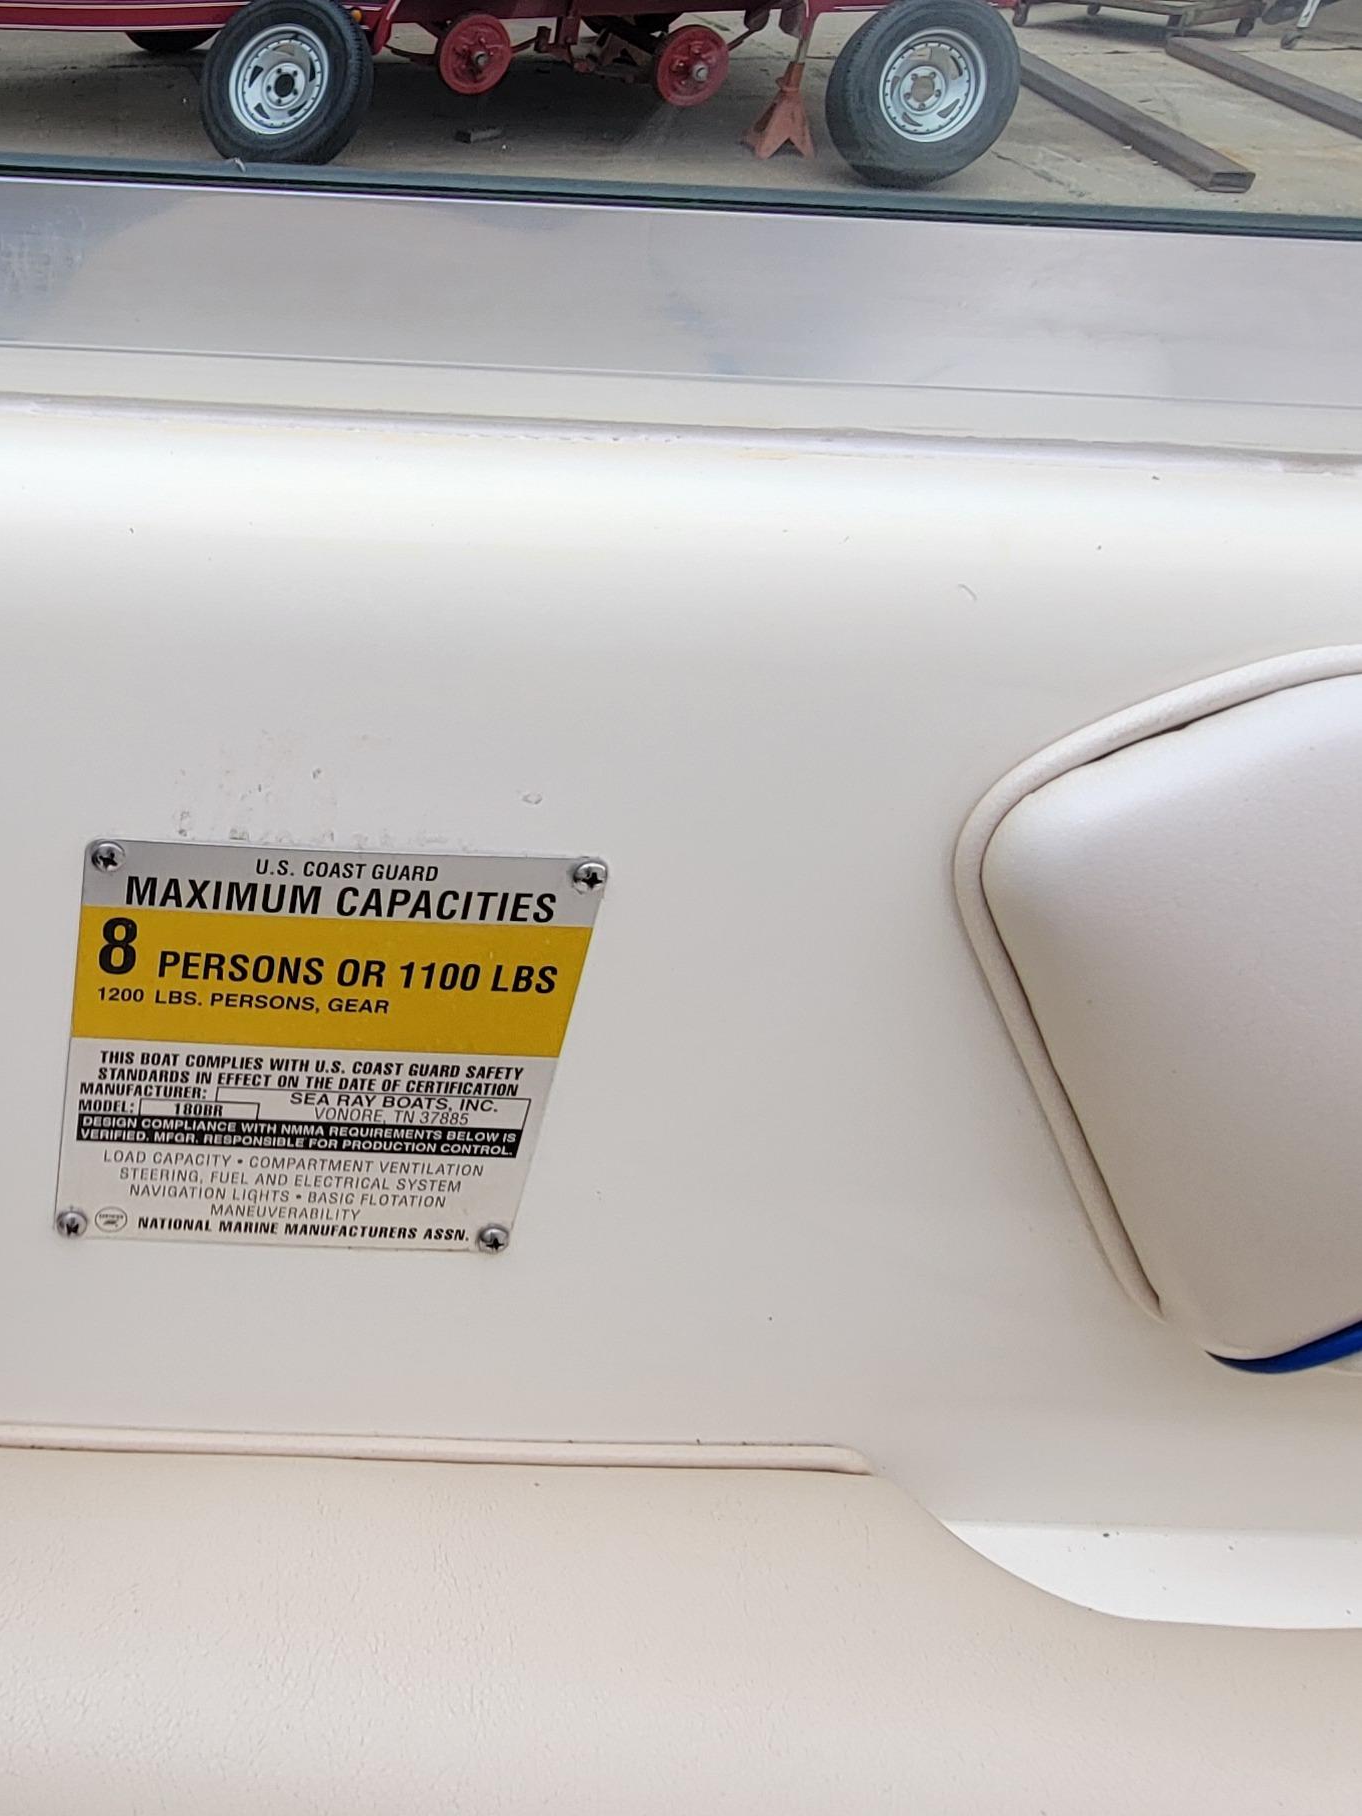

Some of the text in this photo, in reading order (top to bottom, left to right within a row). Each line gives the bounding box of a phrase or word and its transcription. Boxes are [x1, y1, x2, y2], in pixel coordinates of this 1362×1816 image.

[256, 859, 439, 882] U.S. COAST GUARD
[126, 876, 557, 923] MAXIMUM CAPACITIES
[98, 917, 558, 994] 8 PERSONS OR 1100 LBS
[98, 987, 389, 1014] 1200 LBS. PERSONS, GEAR
[100, 1050, 524, 1080] THIS BOAT COMPLIES WITH U.S. COAST GUARD SAFETY
[98, 1067, 518, 1096] STANDARDS IN EFFECT ON THE DATE OF CERTIFICATION
[78, 1099, 135, 1113] MODEL:
[80, 1082, 498, 1112] MANUFACTURER: SEA RAY BOATS, INC.
[82, 1115, 517, 1143] DESIGN COMPLIANCE WITH NMMA REQUIREMENTS BELOW IS
[314, 1107, 469, 1126] VONORE, TN 37885
[79, 1128, 513, 1156] VERIFIED. MFGR. RESPONSIBLE FOR PRODUCTION CONTROL.
[103, 1149, 484, 1177] LOAD CAPACITY COMPARTMENT VENTILATION
[120, 1167, 462, 1193] STEERING, FUEL AND ELECTRICAL SYSTEM
[130, 1184, 446, 1208] NAVIGATION LIGHTS BASIC FLOTATION
[210, 1204, 361, 1220] MANEUVERABILITY
[138, 1217, 213, 1232] NATIONAL
[218, 1219, 278, 1235] MARINE
[284, 1222, 418, 1239] MANUFACTURERS
[423, 1228, 469, 1242] ASSN.
